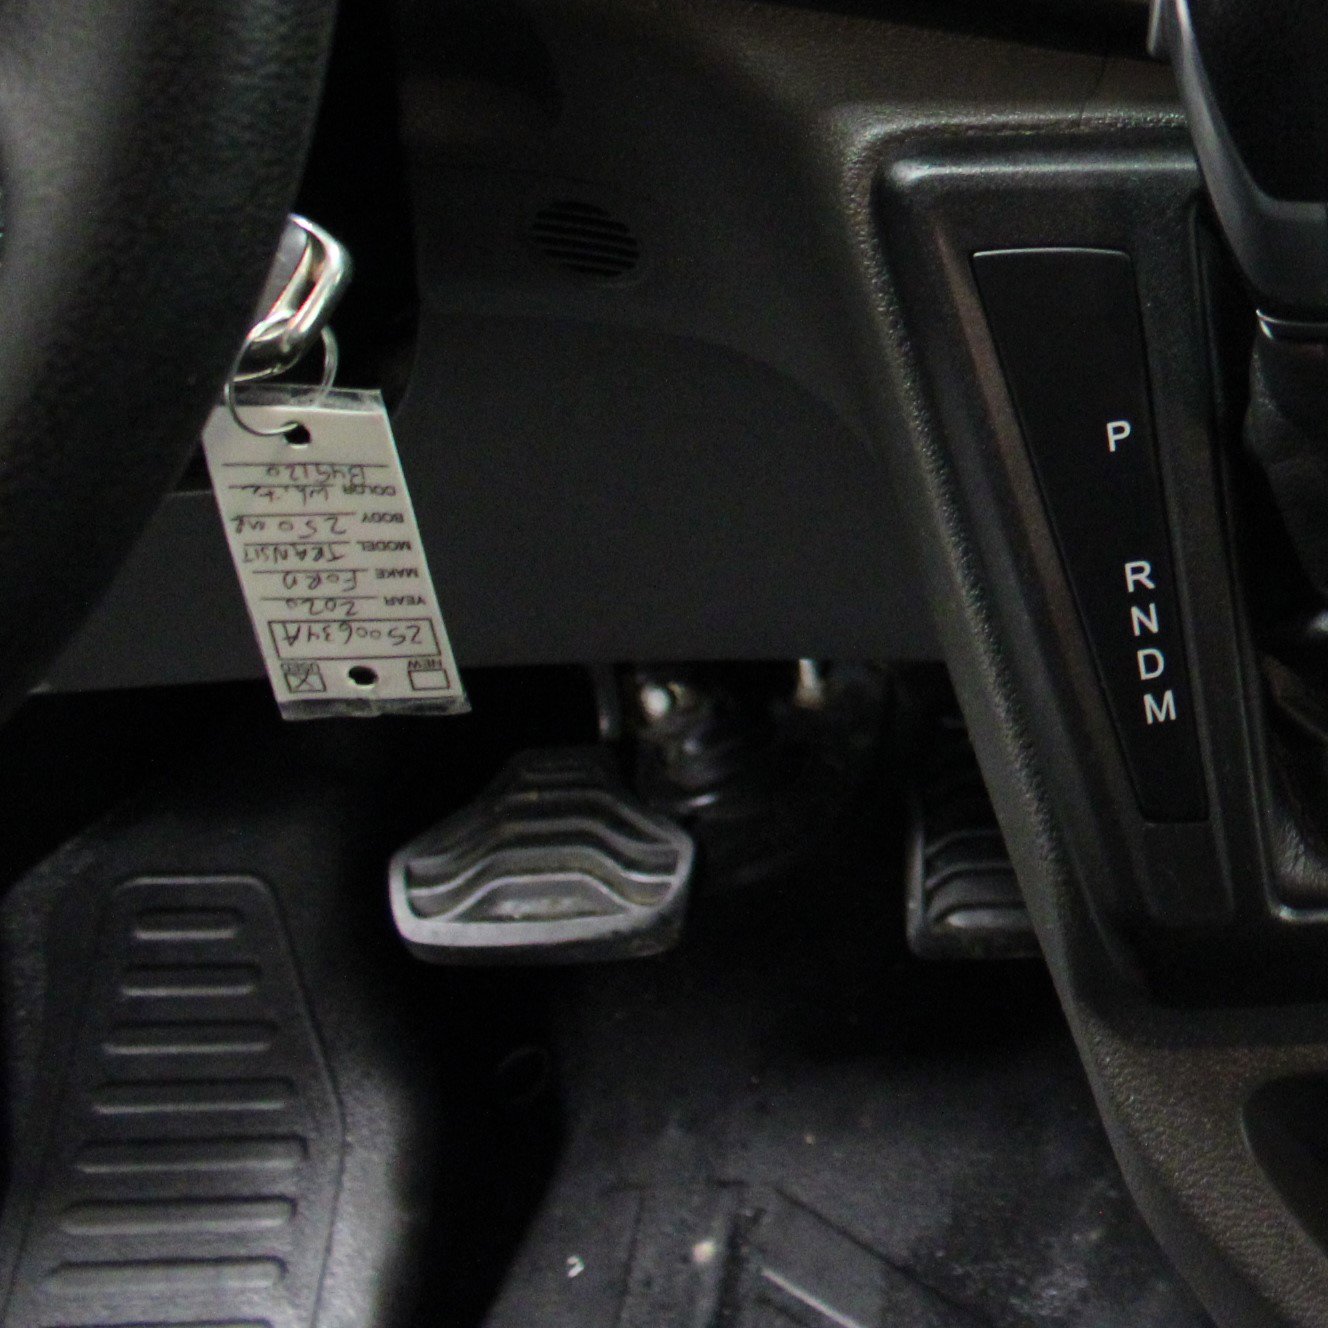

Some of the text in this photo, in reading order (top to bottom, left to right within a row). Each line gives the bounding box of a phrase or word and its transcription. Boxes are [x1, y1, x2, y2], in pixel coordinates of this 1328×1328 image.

[1106, 420, 1131, 452] P
[342, 484, 396, 497] COLOR
[361, 512, 404, 523] BODY
[358, 540, 411, 552] MODEL
[375, 568, 419, 579] MAKE
[1124, 560, 1155, 593] R
[285, 595, 426, 617] YEAR 2020
[1130, 603, 1159, 637] N
[1136, 648, 1165, 681] D
[1143, 689, 1176, 725] M
